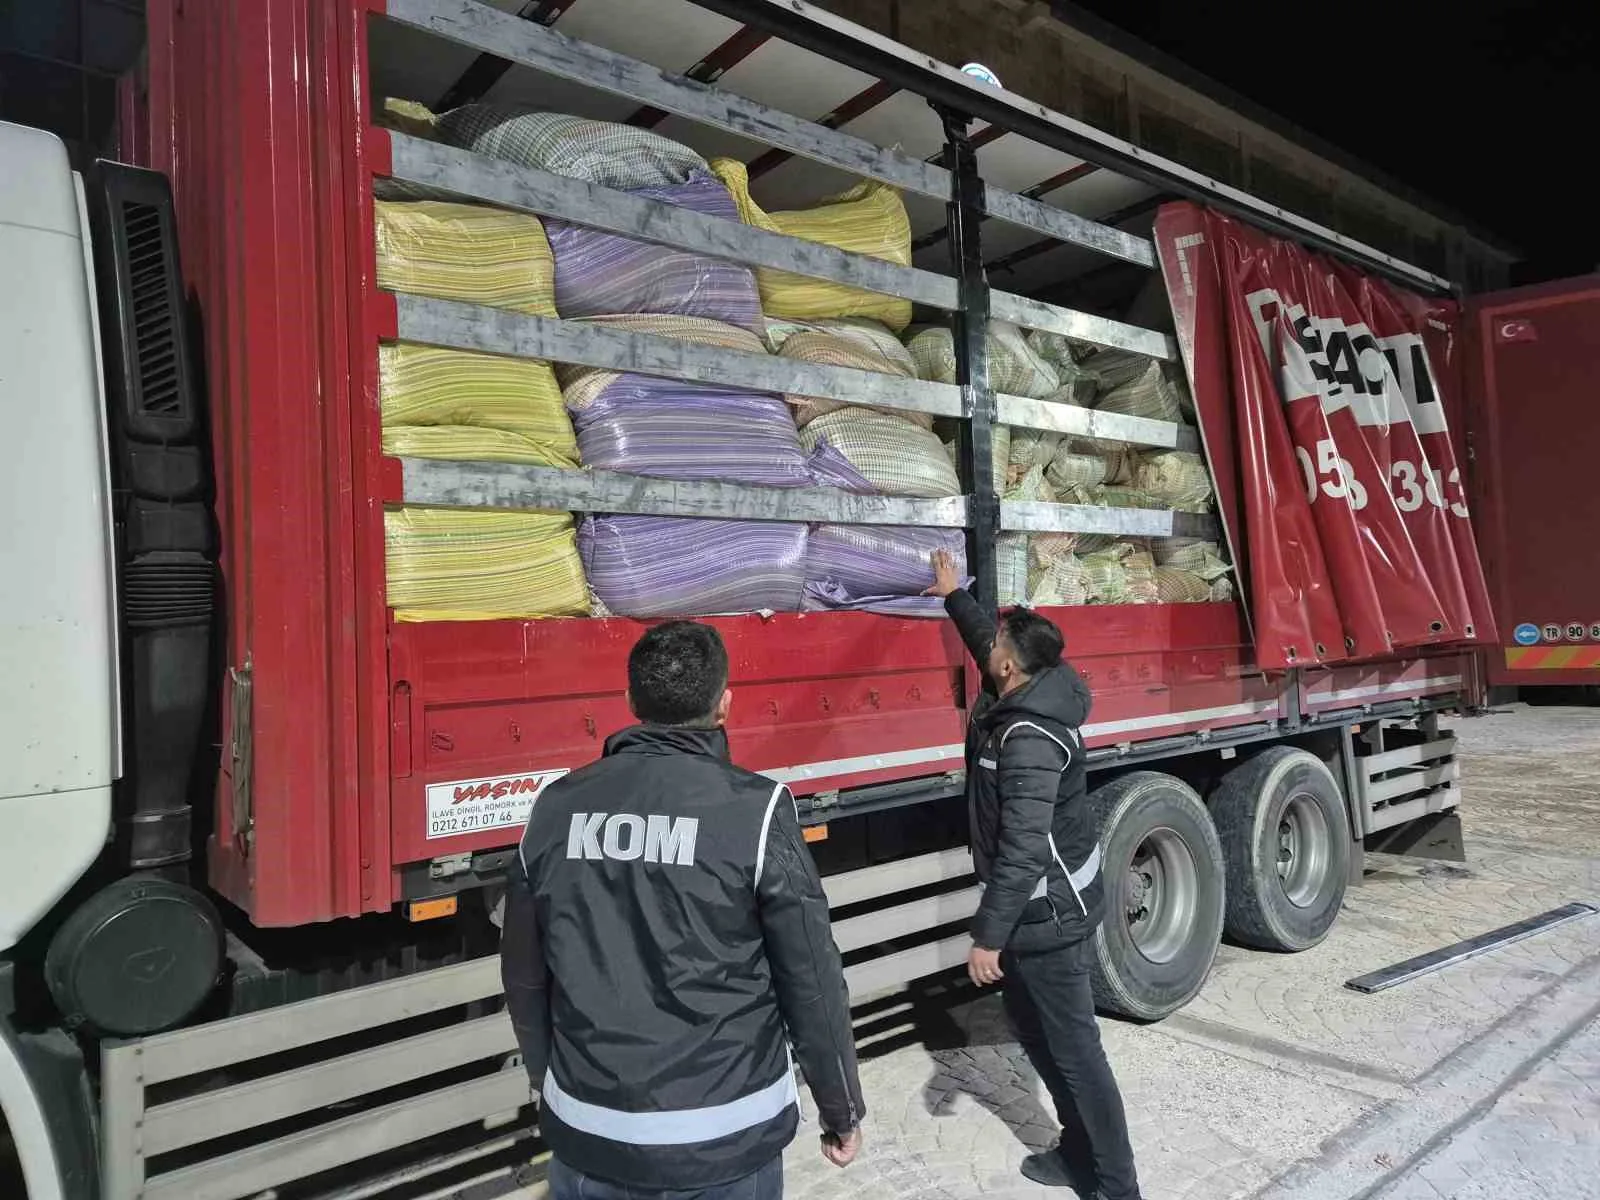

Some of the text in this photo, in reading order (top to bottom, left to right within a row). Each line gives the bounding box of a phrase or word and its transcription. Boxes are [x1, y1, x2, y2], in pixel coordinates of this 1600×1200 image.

[1546, 627, 1558, 638] TR
[1568, 626, 1583, 637] 90
[432, 810, 512, 832] 0212 671 07 46
[566, 812, 699, 866] KOM
